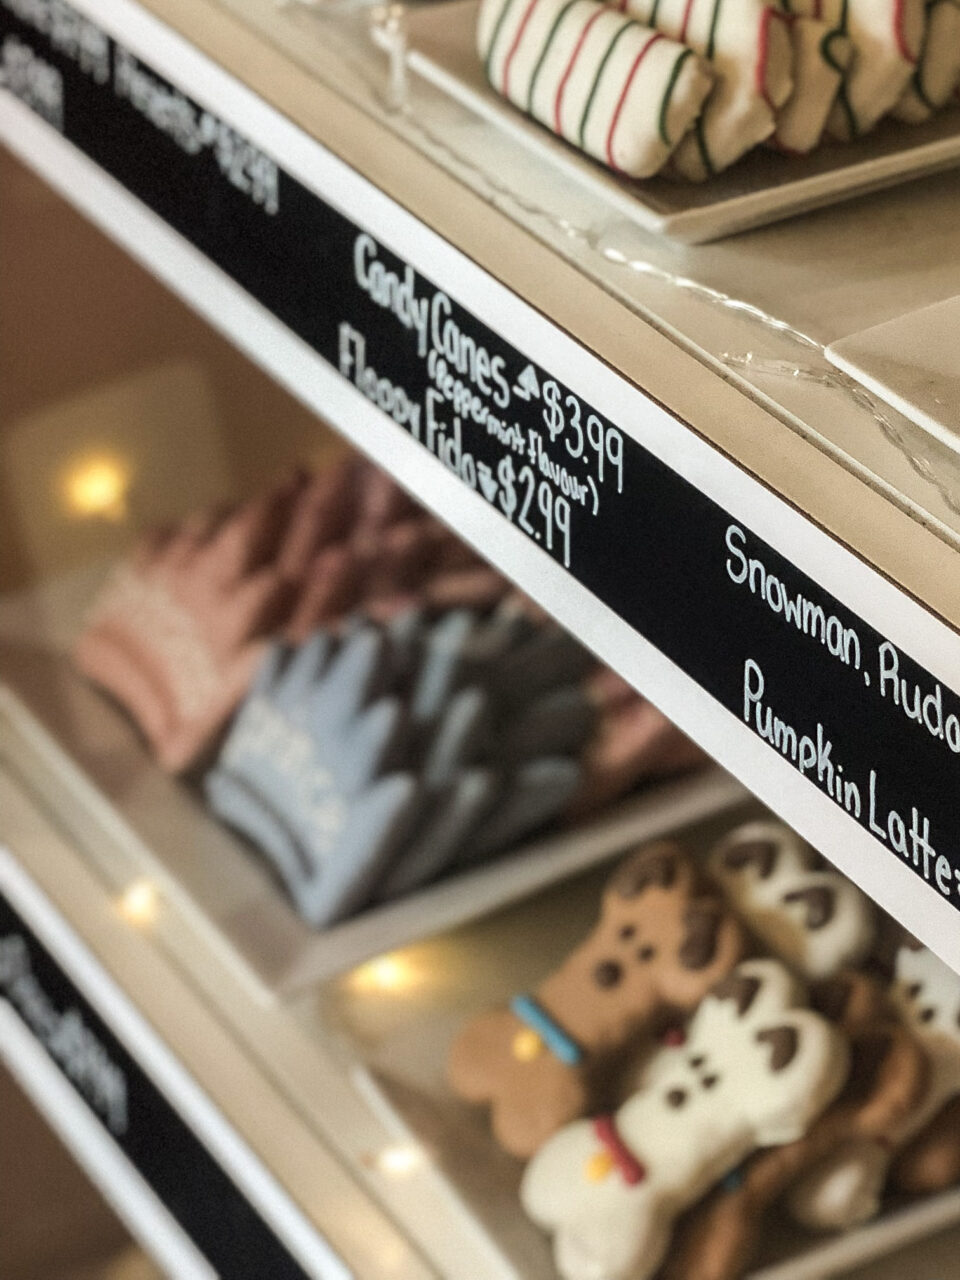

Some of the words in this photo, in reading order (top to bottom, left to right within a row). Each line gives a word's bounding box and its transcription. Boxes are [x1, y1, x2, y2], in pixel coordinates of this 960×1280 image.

[353, 232, 429, 358] Candy
[430, 290, 511, 409] Canes
[542, 379, 624, 495] $3.99
[425, 386, 478, 490] Fido
[497, 453, 571, 569] $2.99
[743, 658, 862, 819] Pumpkin
[867, 769, 955, 898] Latte
